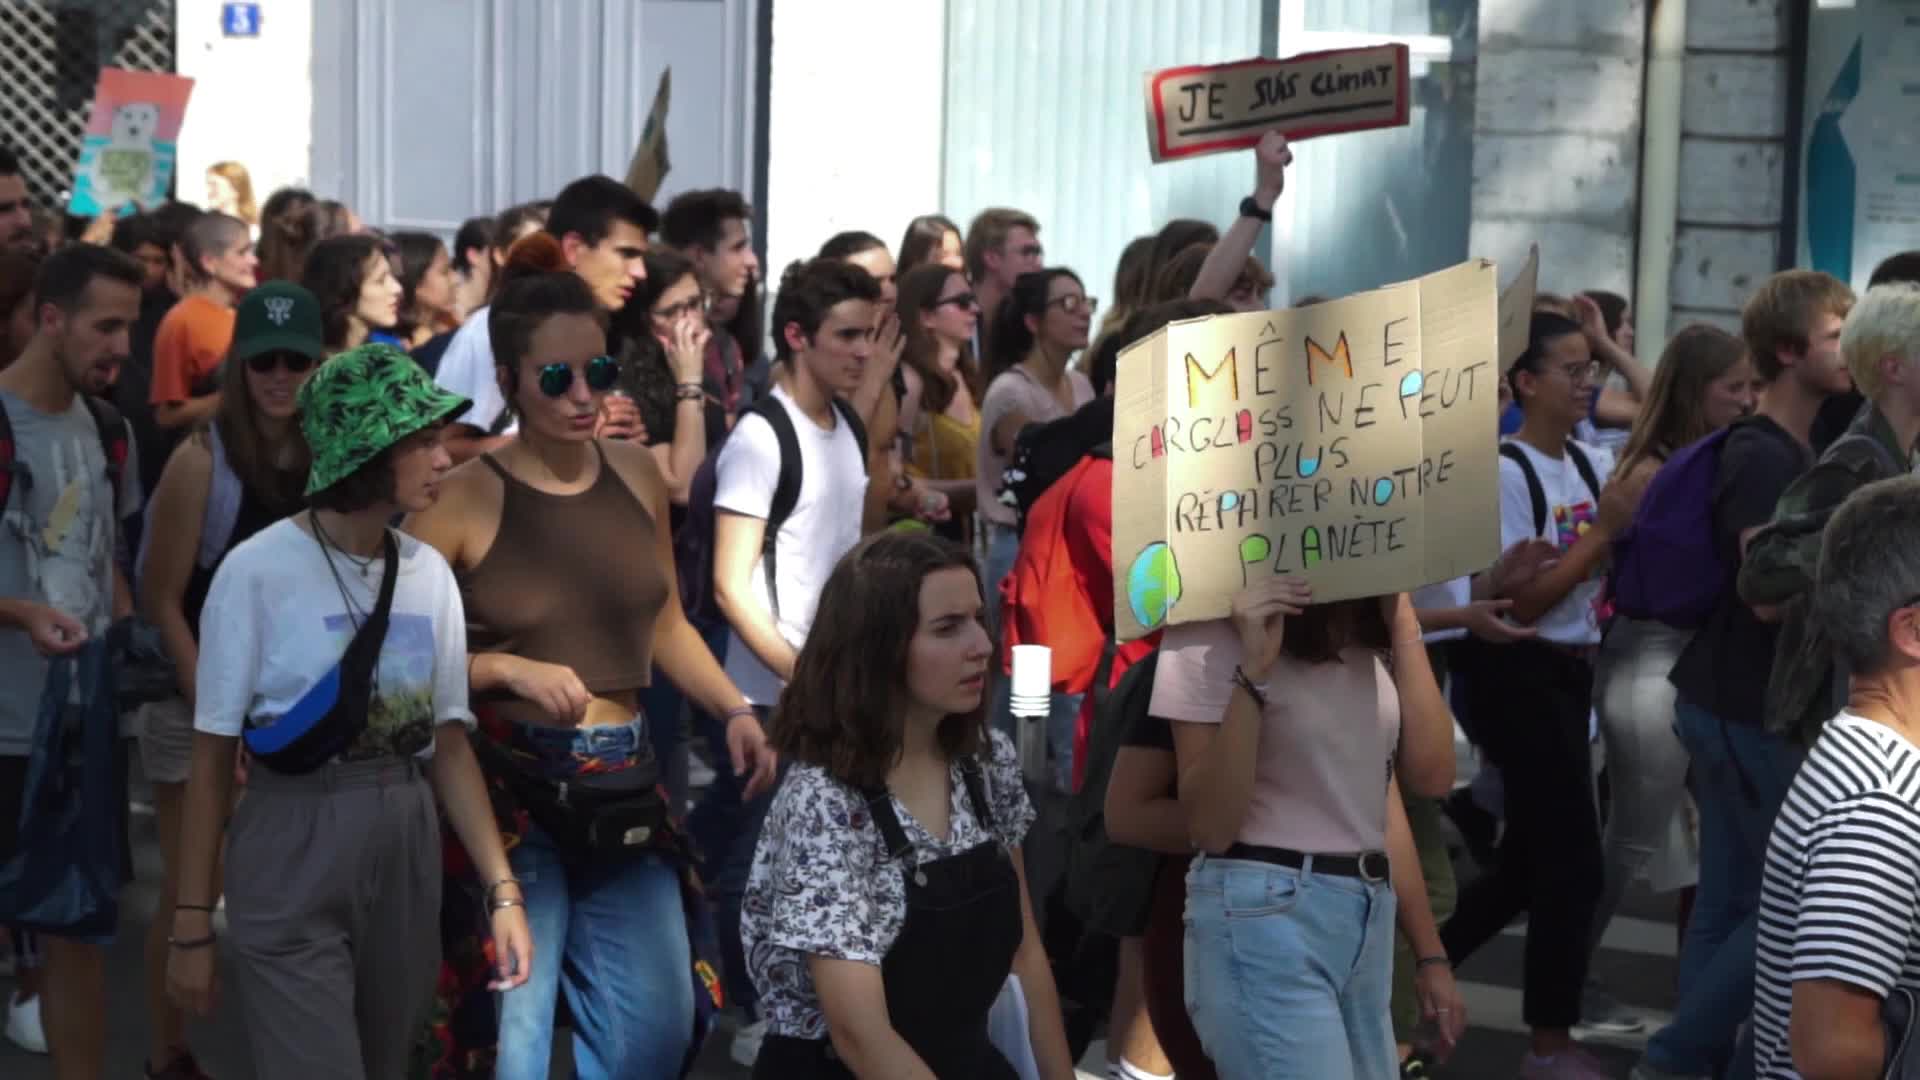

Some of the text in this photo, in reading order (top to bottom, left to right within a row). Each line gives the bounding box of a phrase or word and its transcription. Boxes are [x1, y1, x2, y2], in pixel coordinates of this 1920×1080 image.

[1178, 83, 1227, 123] JE
[1184, 316, 1408, 408] MÊME
[1133, 361, 1489, 470] CARGLASS NE PEUT
[1175, 450, 1455, 533] RÉPARER NOTRE
[1254, 436, 1350, 484] PLUS
[1238, 515, 1407, 588] PLANÈTE
